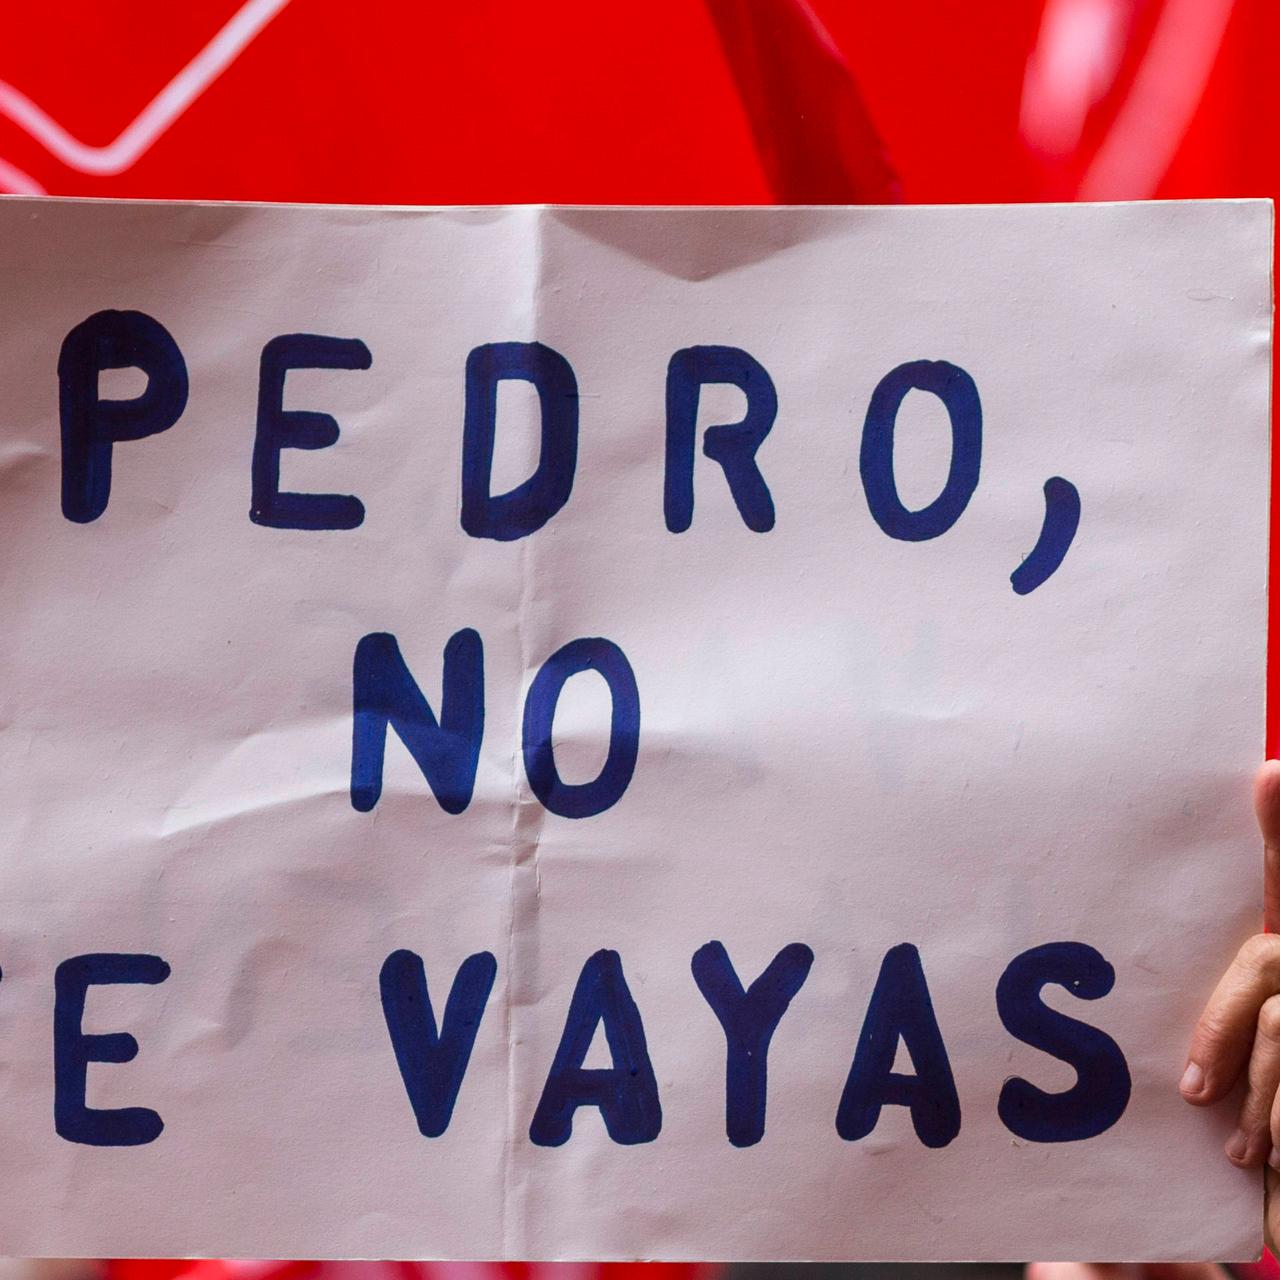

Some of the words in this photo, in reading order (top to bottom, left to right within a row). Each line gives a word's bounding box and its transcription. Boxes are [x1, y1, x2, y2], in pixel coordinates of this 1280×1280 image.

[58, 309, 1082, 595] PEDRO,
[350, 627, 641, 819] NO
[378, 940, 1132, 1148] VAYAS
